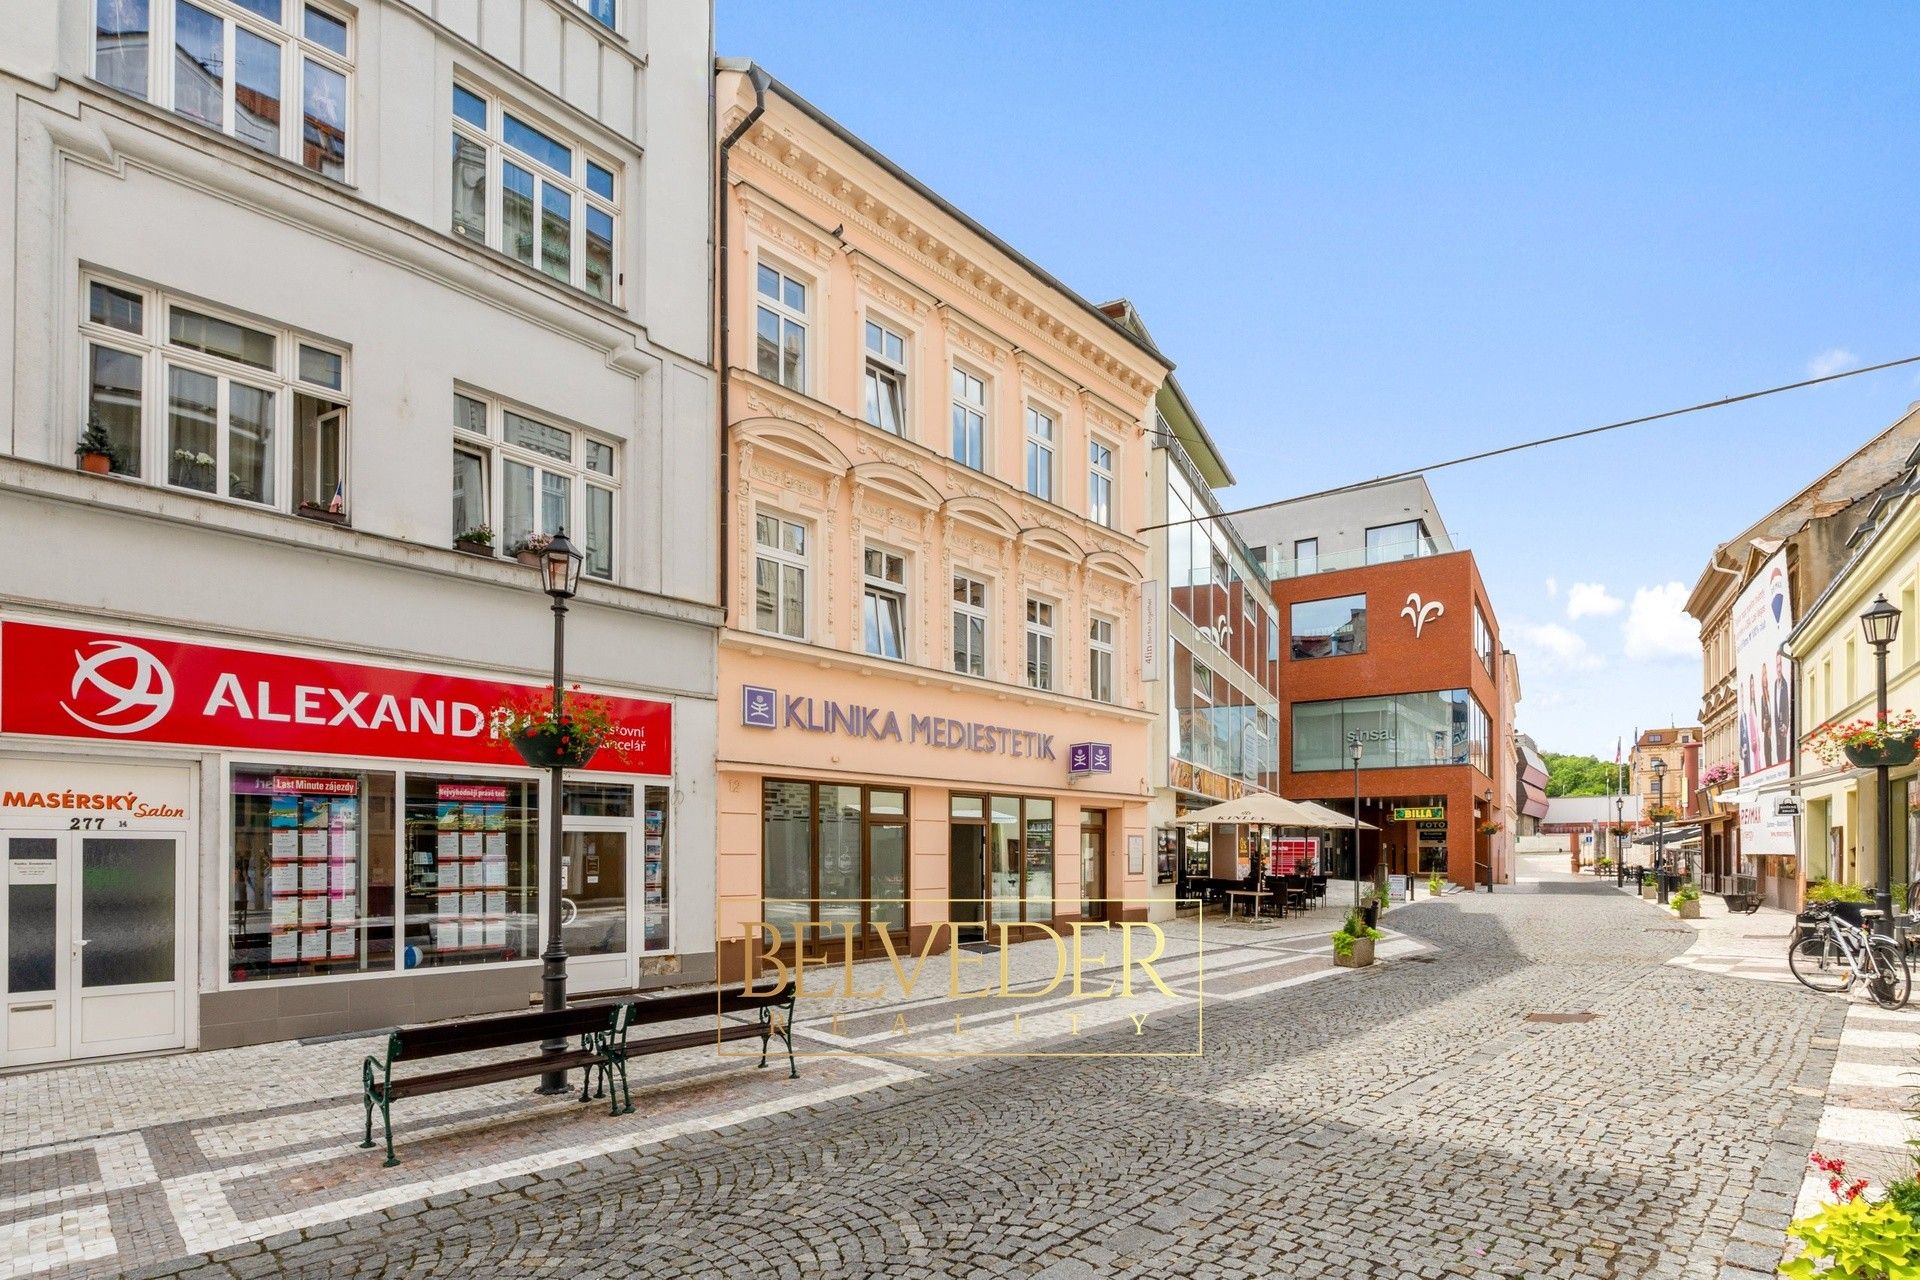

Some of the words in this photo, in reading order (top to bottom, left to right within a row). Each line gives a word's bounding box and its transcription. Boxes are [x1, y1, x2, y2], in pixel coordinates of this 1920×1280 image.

[606, 725, 646, 738] stovní
[784, 694, 903, 742] KLINIKA
[908, 713, 1056, 761] MEDIESTETIK
[1346, 729, 1397, 742] snsa
[276, 779, 295, 789] Last
[295, 780, 324, 791] Minute
[325, 782, 355, 793] zájezdy
[3, 789, 138, 811] MASÉRSKÝ
[134, 803, 184, 818] Salon
[1405, 809, 1432, 818] BILLA
[70, 817, 105, 830] 277
